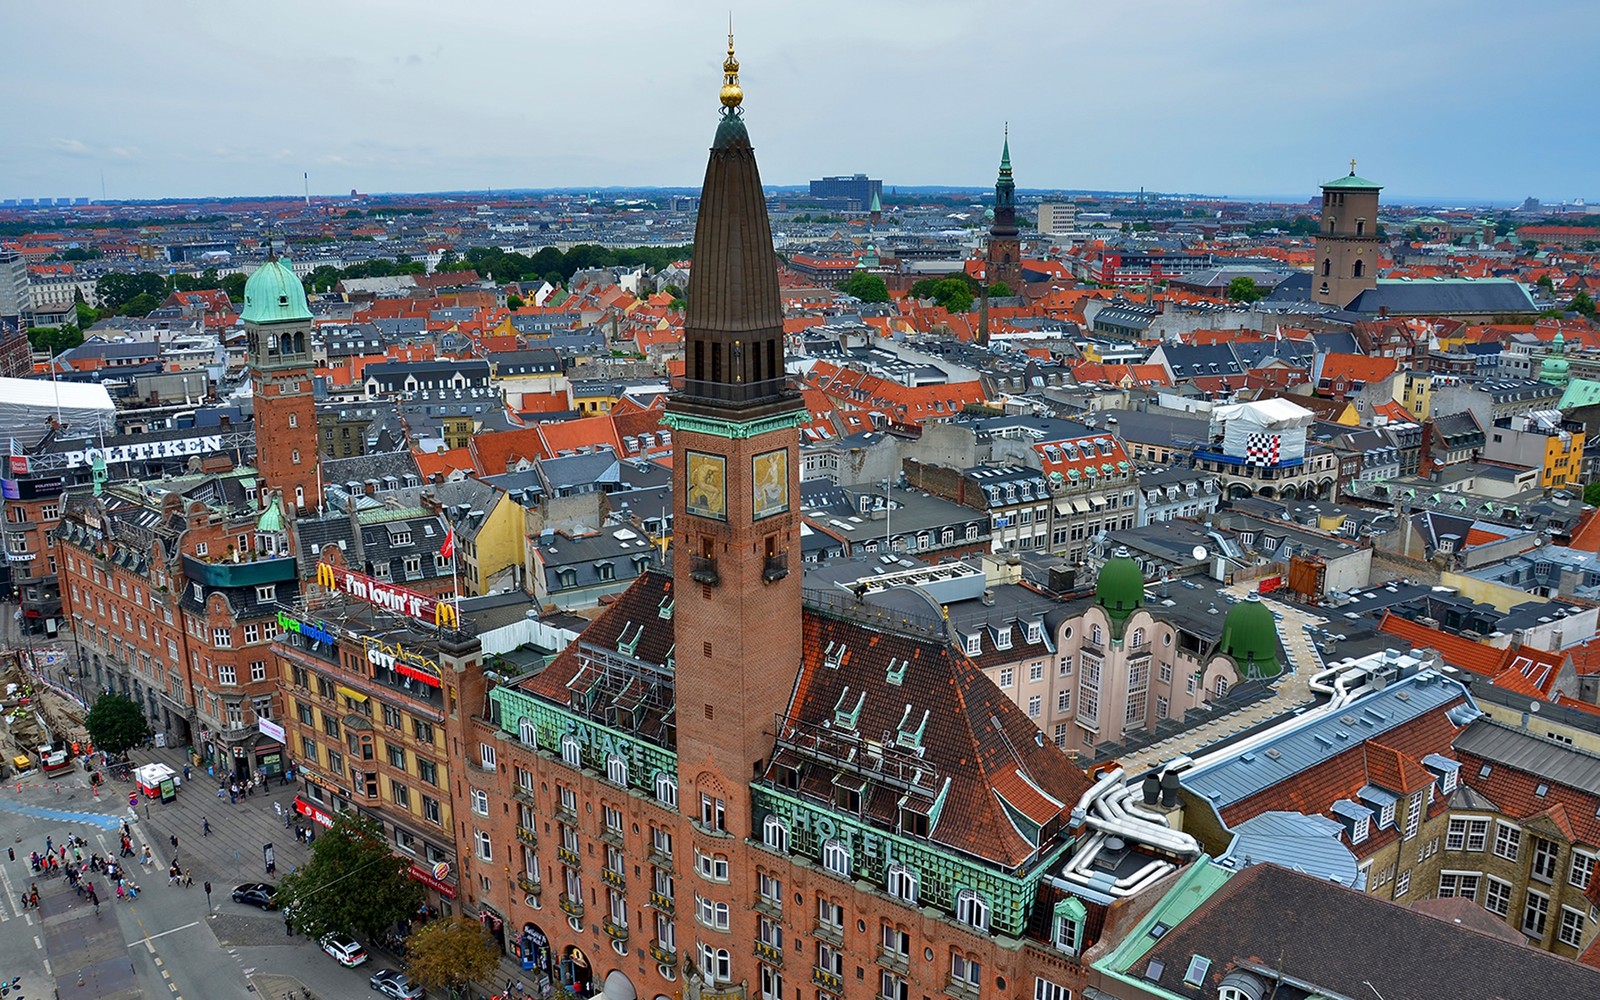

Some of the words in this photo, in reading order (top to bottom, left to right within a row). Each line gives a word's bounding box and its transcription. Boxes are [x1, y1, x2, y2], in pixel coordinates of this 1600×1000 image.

[65, 434, 222, 468] POLITIKEN
[345, 573, 367, 598] I'm
[368, 581, 408, 612] lovin'
[367, 649, 396, 671] CITY
[565, 719, 646, 767] PALACE
[793, 806, 899, 867] HOTEL
